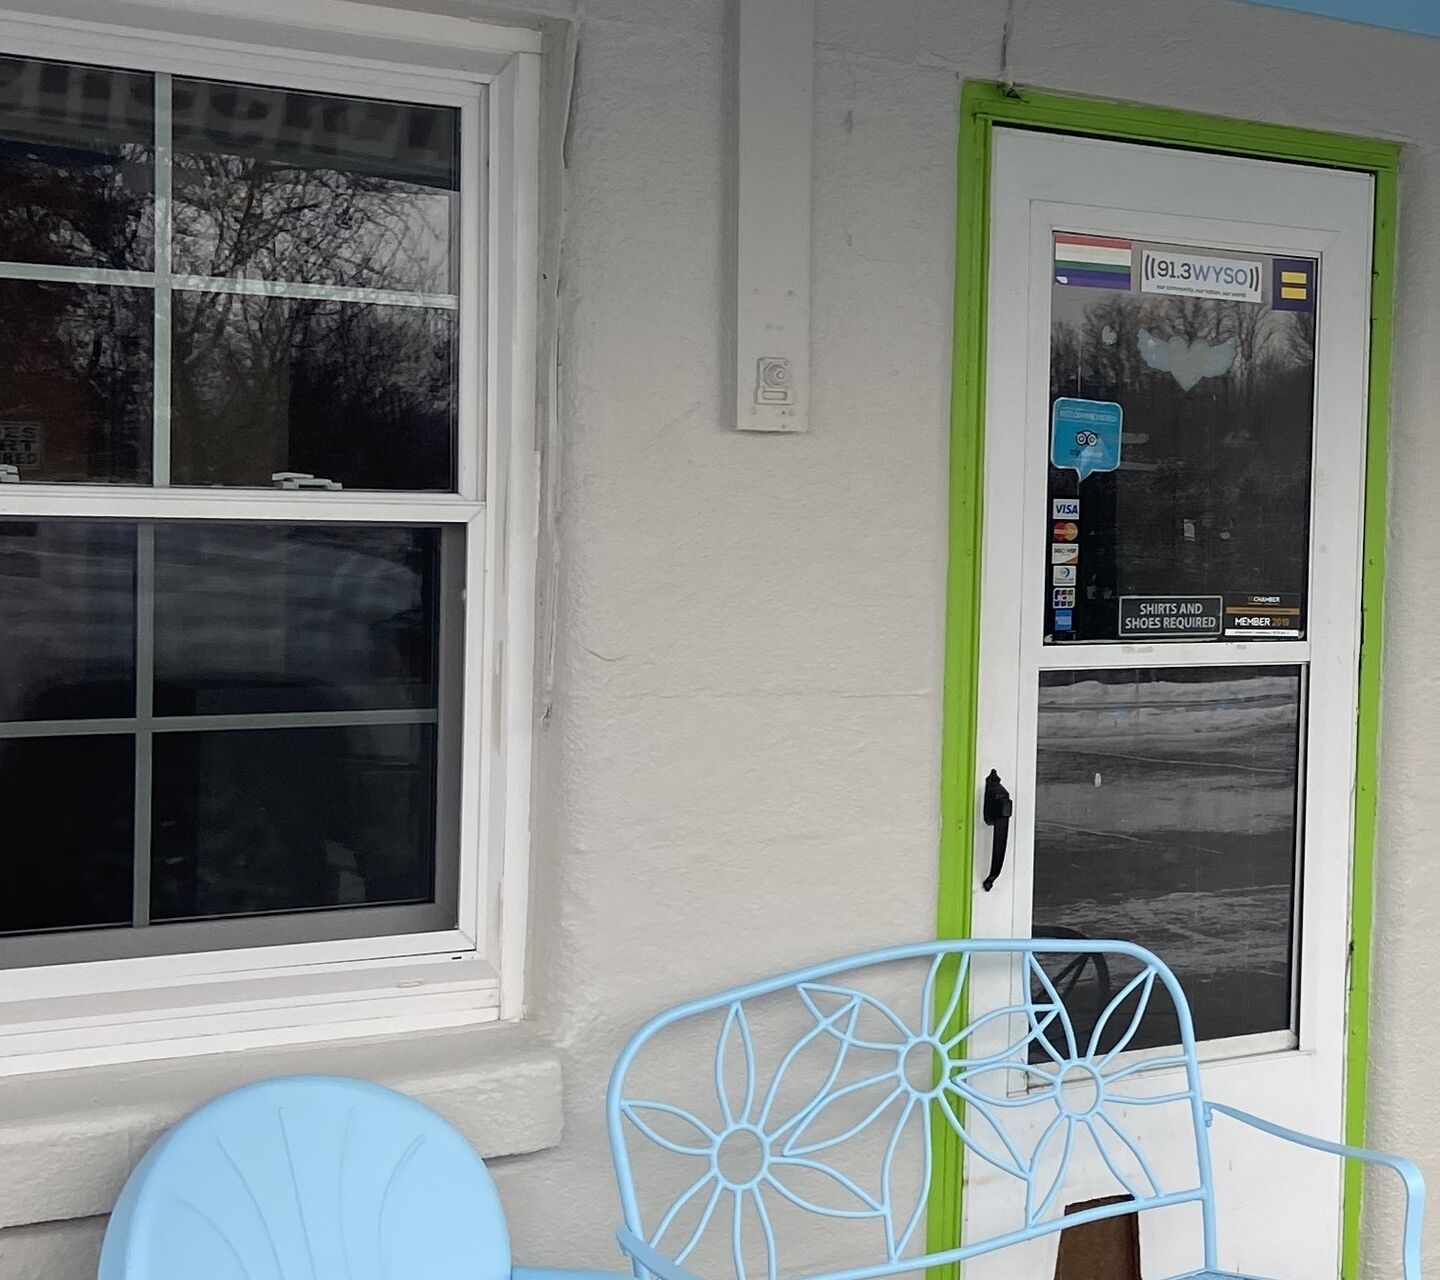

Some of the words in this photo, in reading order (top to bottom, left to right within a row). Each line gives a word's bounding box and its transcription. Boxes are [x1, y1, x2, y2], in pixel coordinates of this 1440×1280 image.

[1055, 504, 1078, 515] VISA
[1140, 603, 1177, 615] SHIRTS
[1179, 603, 1203, 614] AND
[1125, 617, 1161, 629] SHOES
[1163, 616, 1216, 629] REQUIRED
[1234, 616, 1271, 627] MEMBER
